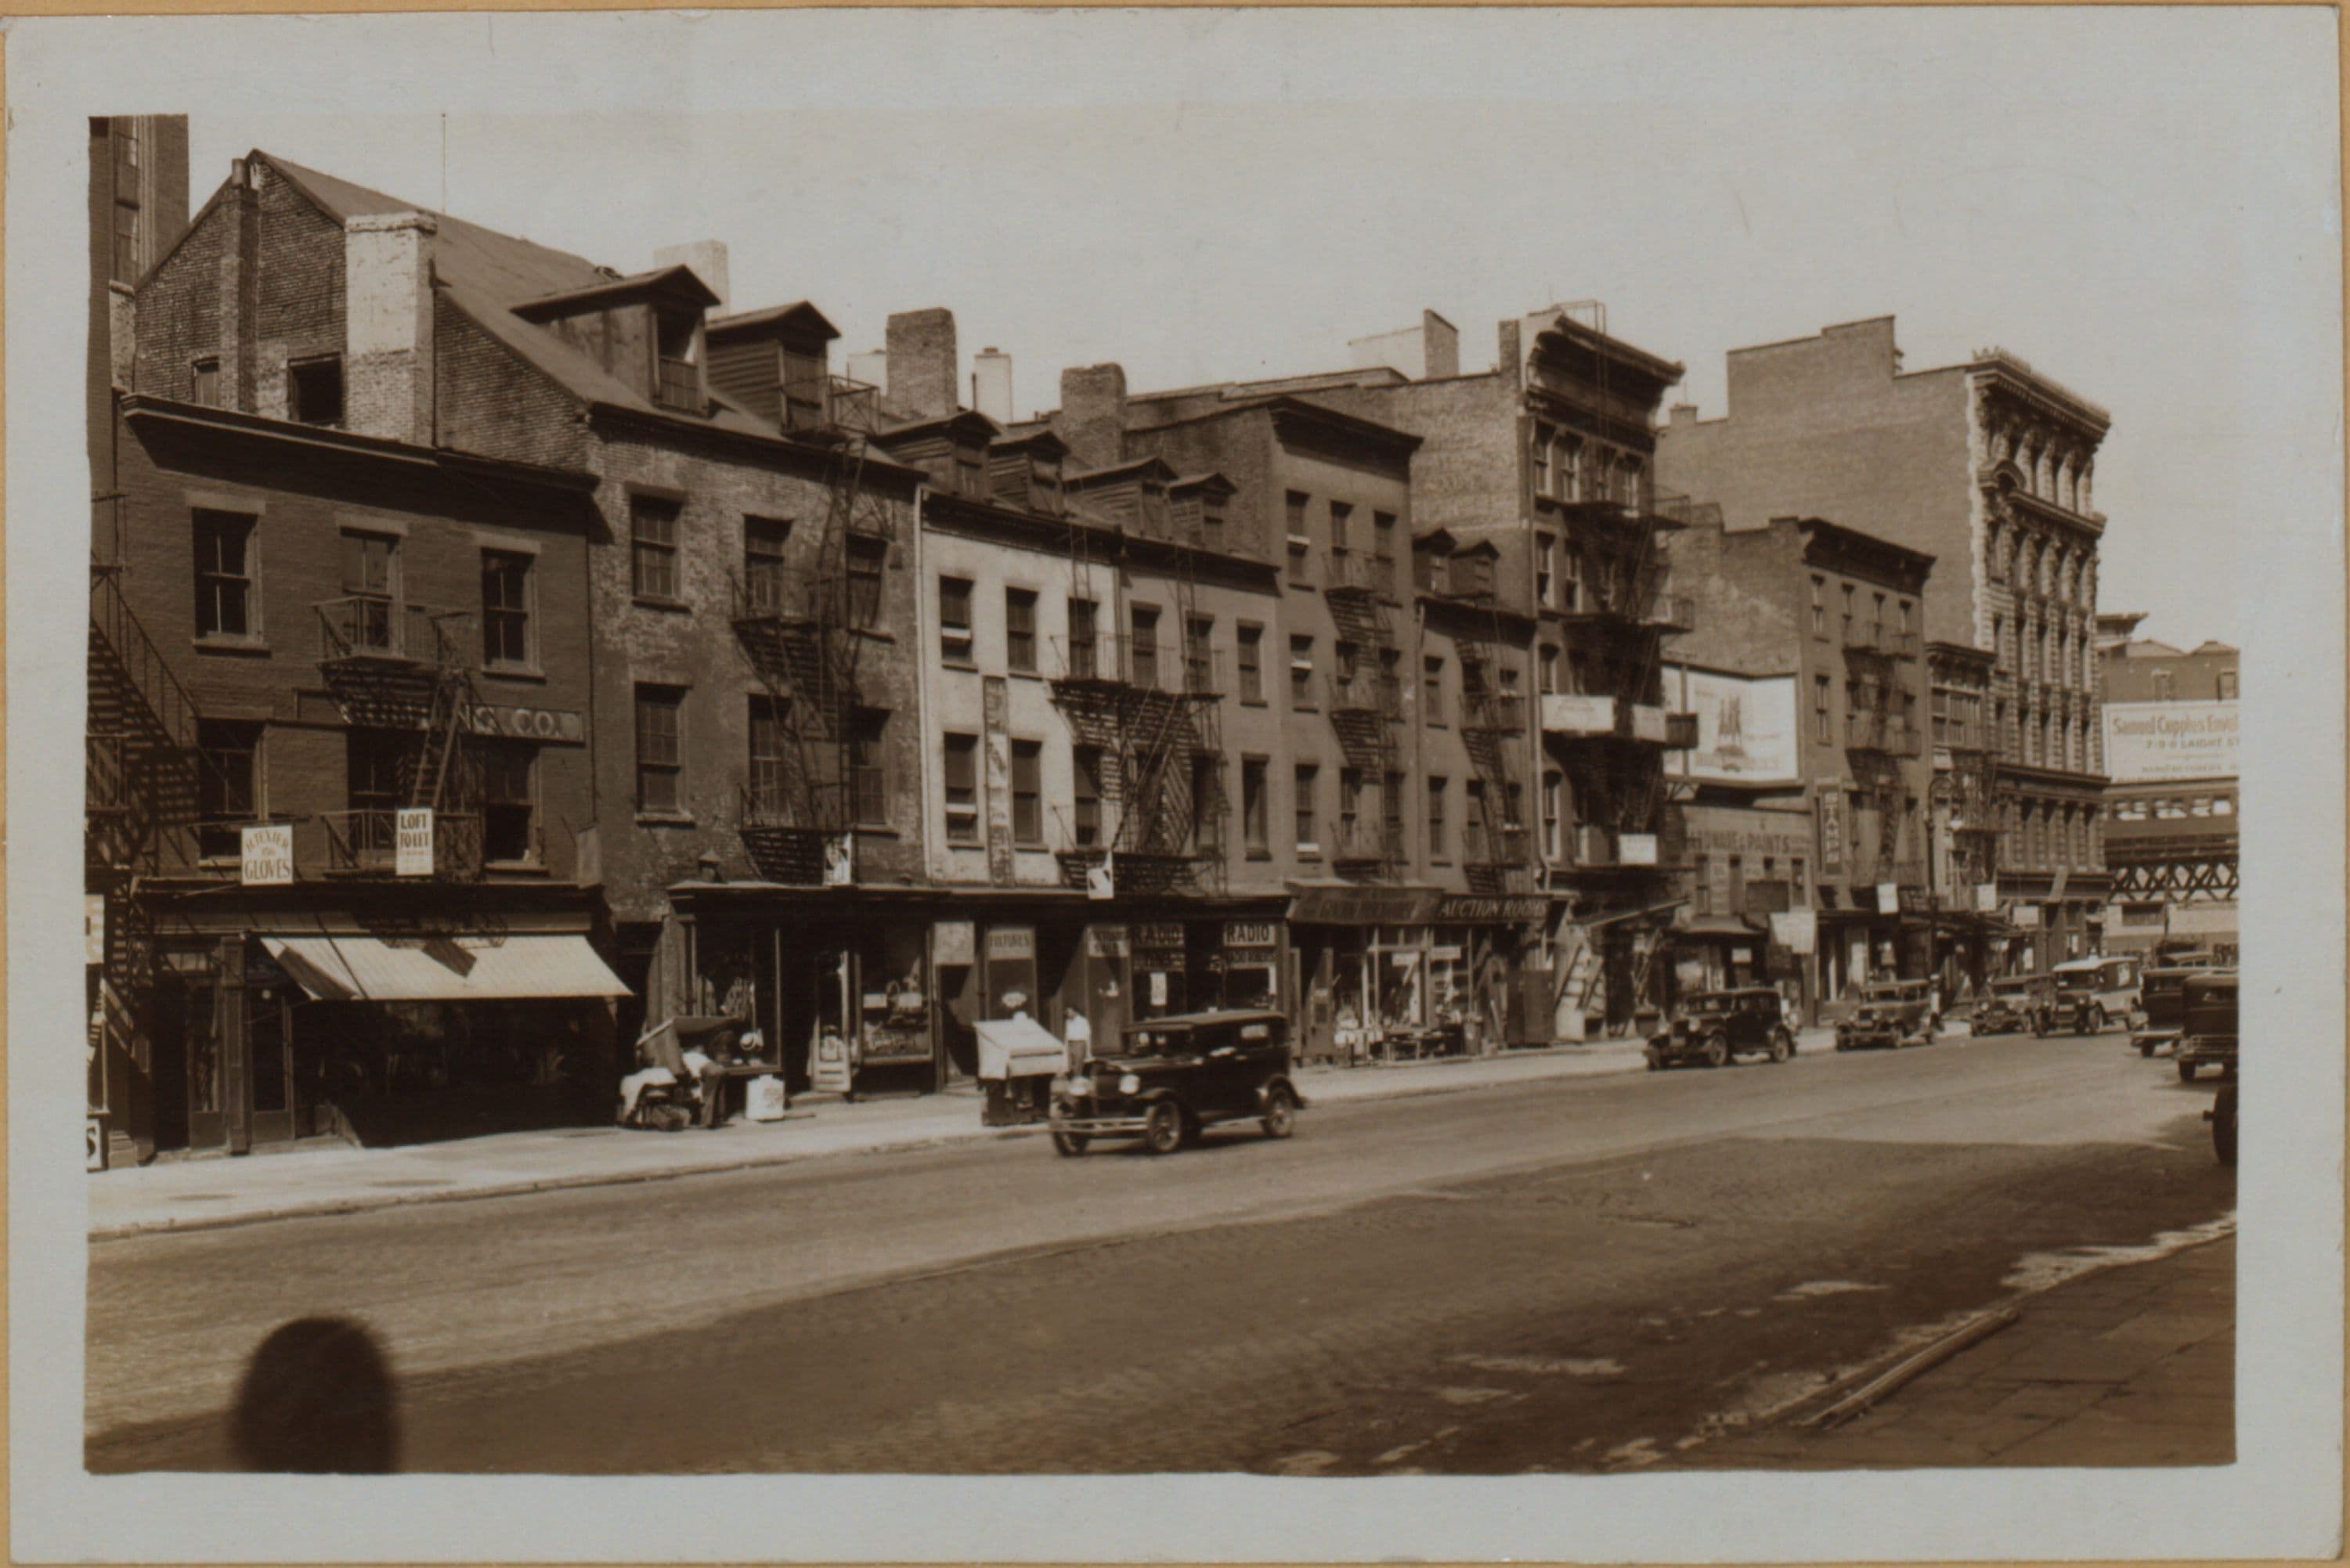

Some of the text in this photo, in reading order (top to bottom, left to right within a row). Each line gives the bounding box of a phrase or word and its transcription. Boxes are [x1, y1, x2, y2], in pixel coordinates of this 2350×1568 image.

[400, 813, 427, 829] LOFT
[1747, 831, 1789, 853] PAINTS
[244, 859, 291, 880] GLOVES
[1442, 899, 1500, 917] AUCTION
[1227, 924, 1269, 942] RADIO
